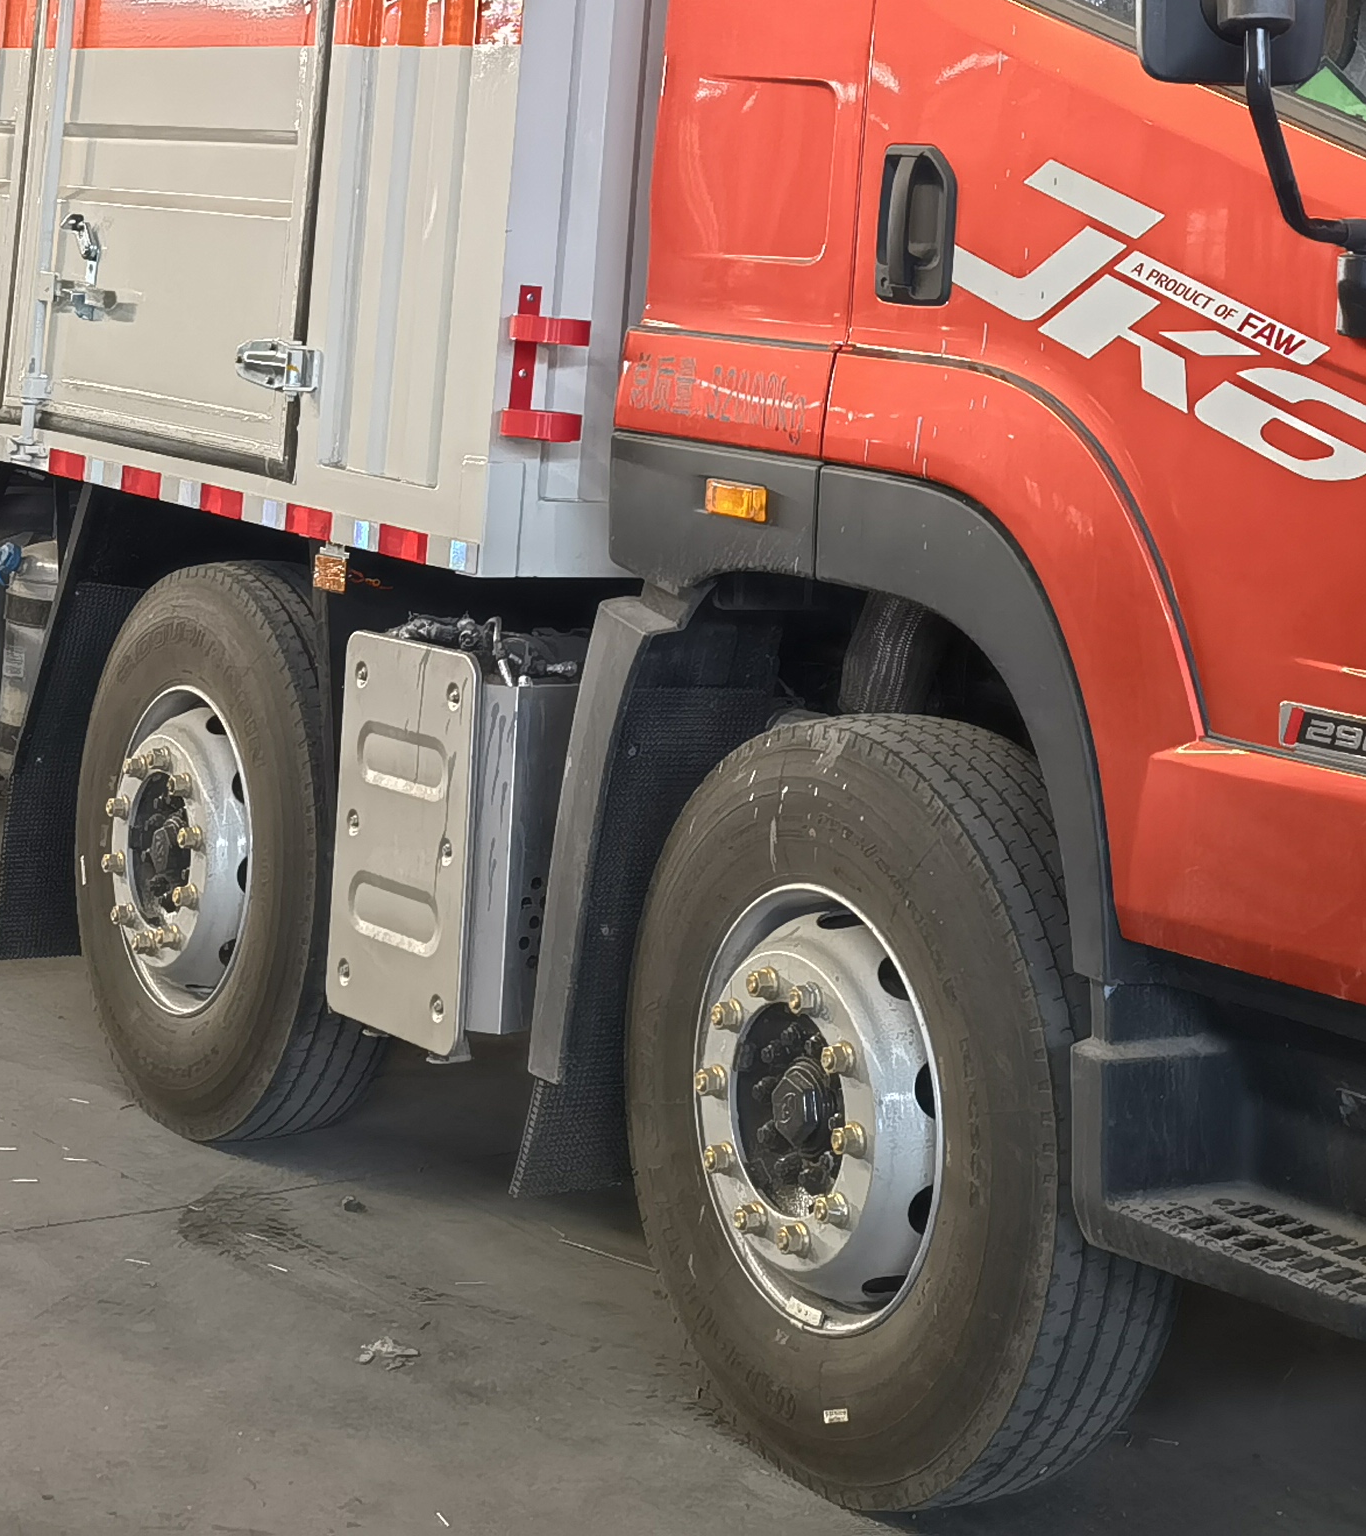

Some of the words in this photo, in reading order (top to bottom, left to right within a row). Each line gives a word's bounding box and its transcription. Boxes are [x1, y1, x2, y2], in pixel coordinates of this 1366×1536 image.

[1131, 262, 1144, 277] A
[1146, 268, 1215, 310] PRODUCT
[1215, 304, 1239, 320] OF
[1237, 312, 1306, 356] FAW
